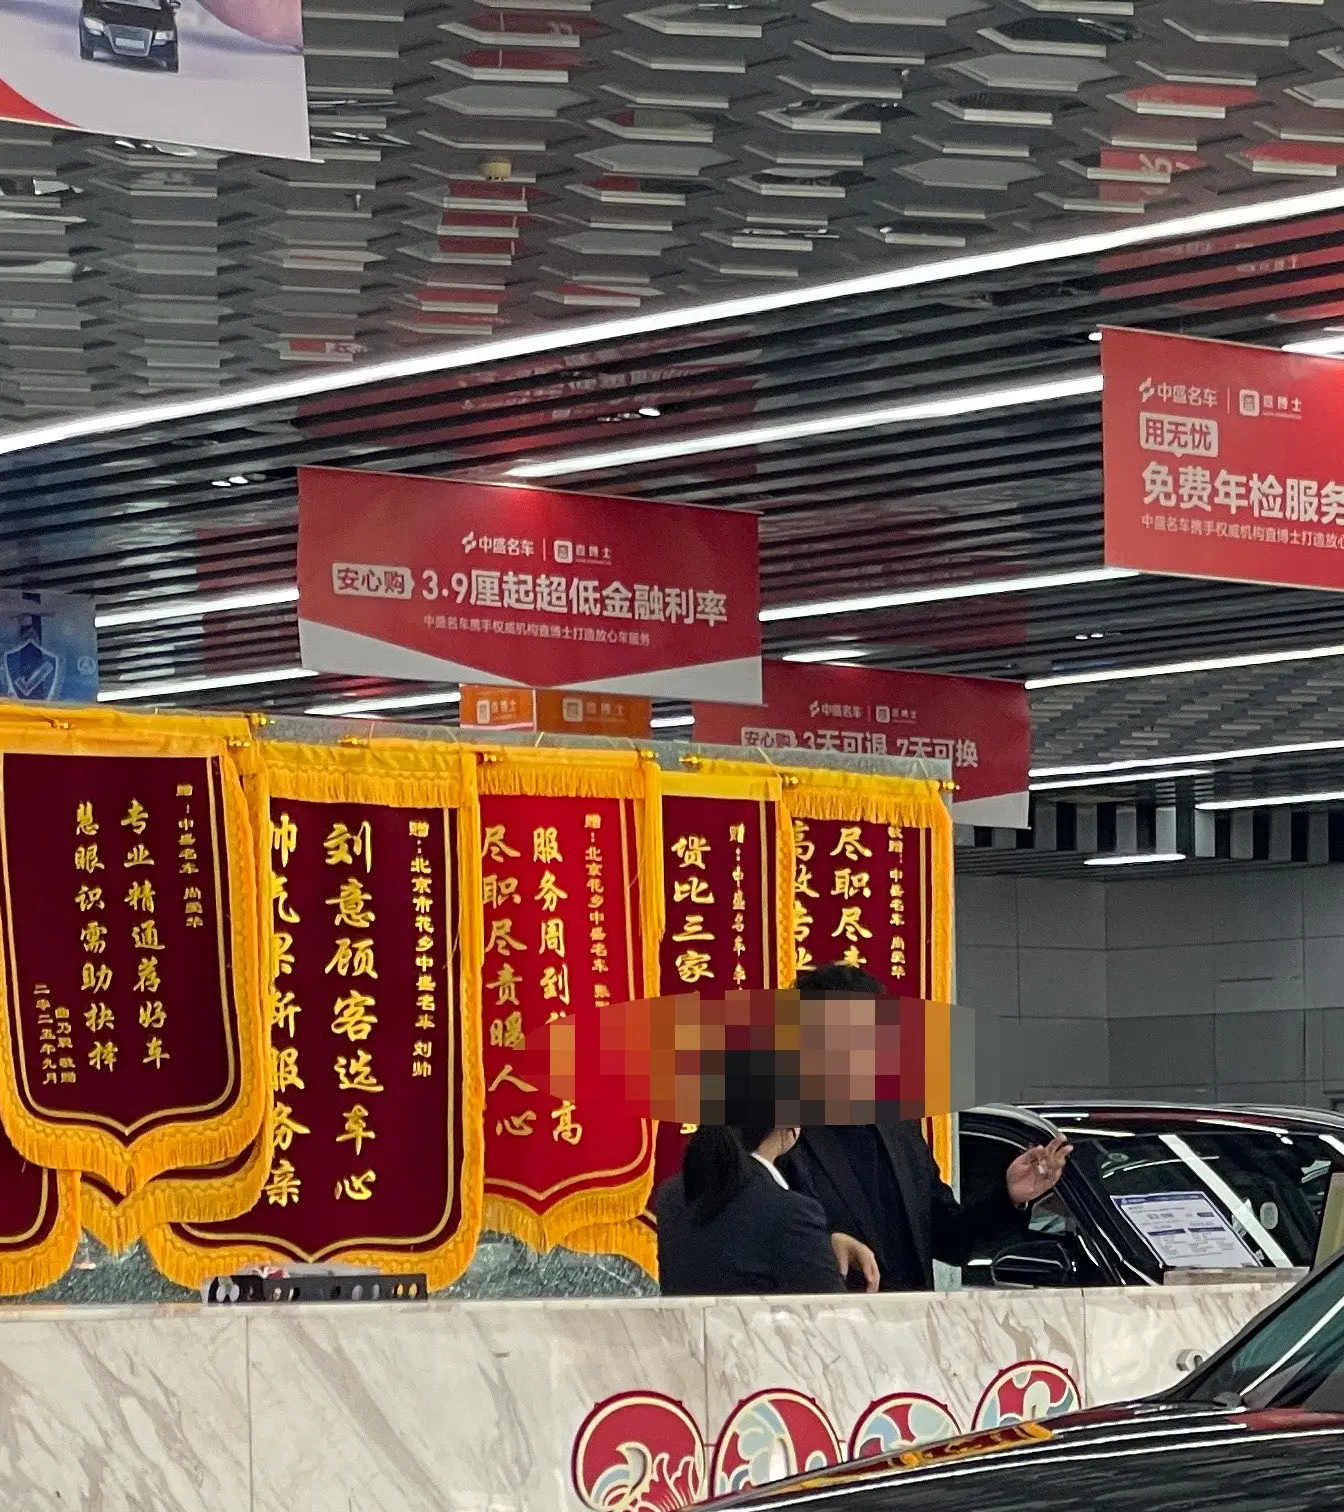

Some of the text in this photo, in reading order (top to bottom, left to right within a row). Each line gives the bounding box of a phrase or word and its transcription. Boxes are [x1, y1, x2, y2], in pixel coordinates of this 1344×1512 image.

[1156, 384, 1218, 408] 中盛名车
[1144, 419, 1213, 451] 用无忧
[478, 535, 535, 557] 中盛名车
[336, 566, 729, 627] 安心购 3.9厘起超低金融利率
[896, 737, 978, 768] 7天可换
[121, 796, 170, 1070] 专业精通荐好车
[532, 825, 584, 1146] 服务周到高
[323, 820, 384, 1202] 刘意顾客选车心
